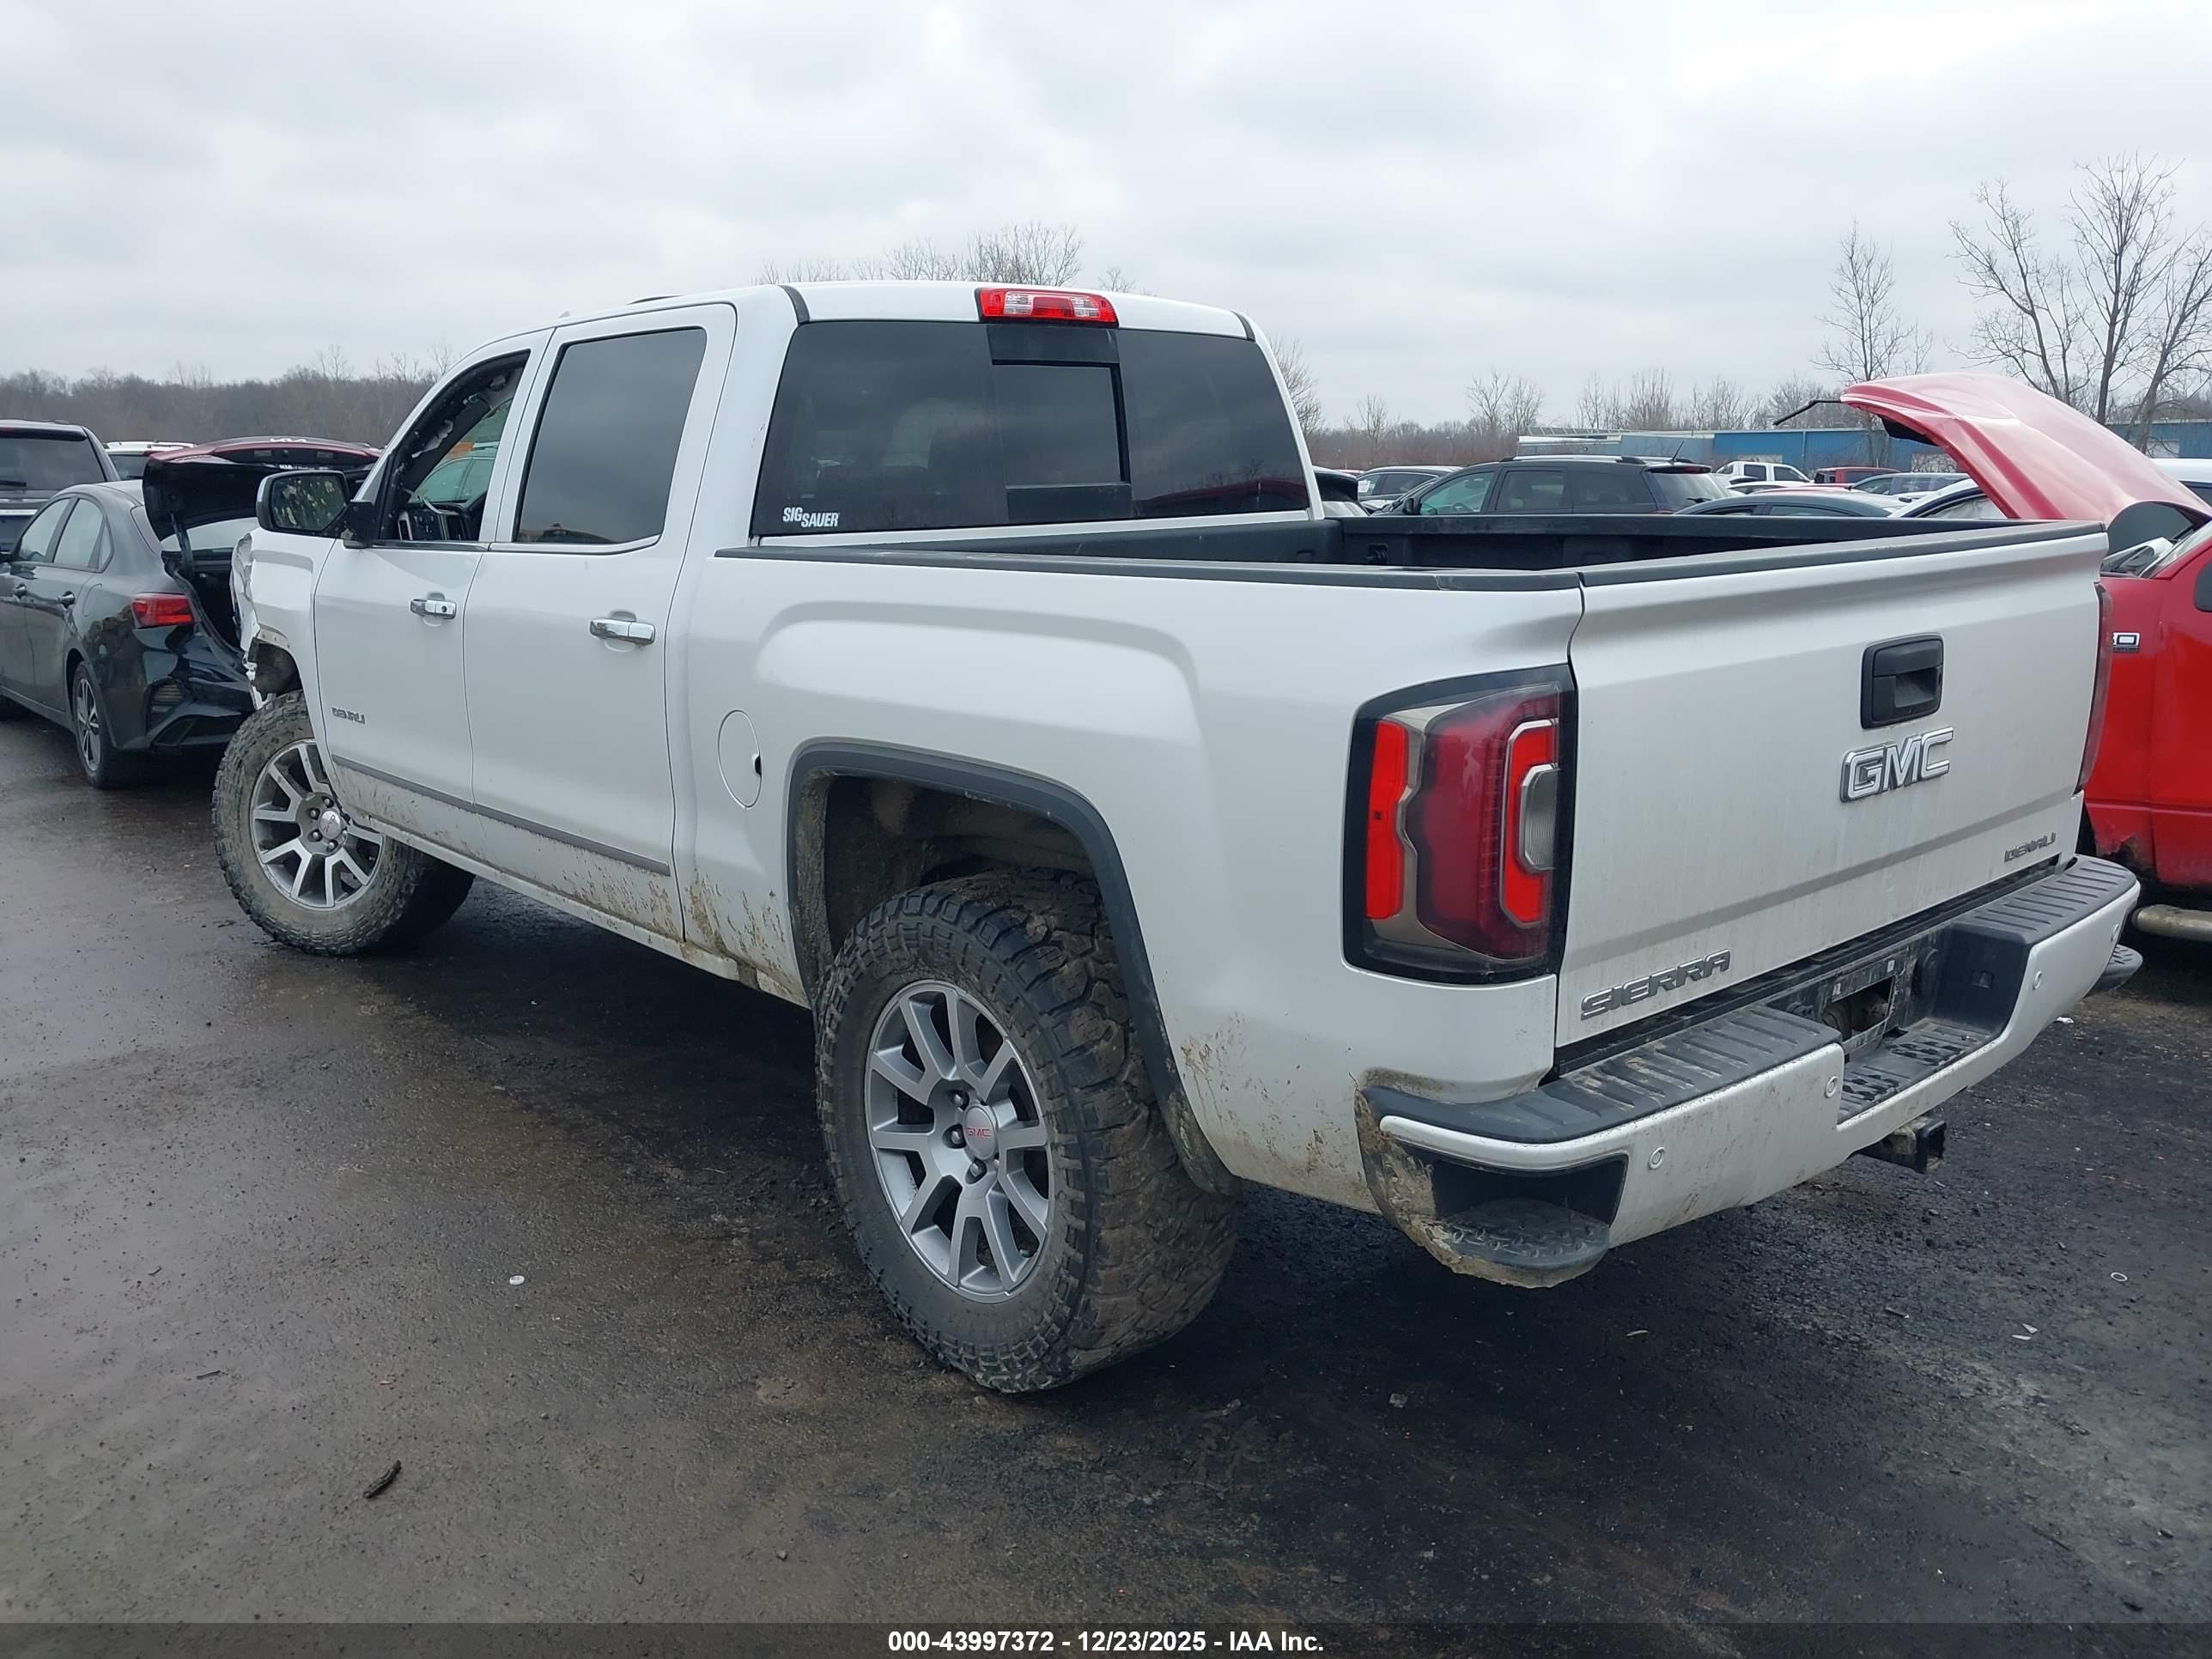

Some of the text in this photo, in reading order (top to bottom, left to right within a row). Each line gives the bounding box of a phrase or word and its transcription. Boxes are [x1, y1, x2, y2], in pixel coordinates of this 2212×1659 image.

[783, 507, 839, 527] SIG SAUER
[1840, 726, 1954, 803] GMC
[1581, 949, 1731, 1021] SIERRA
[967, 1127, 990, 1137] GMC
